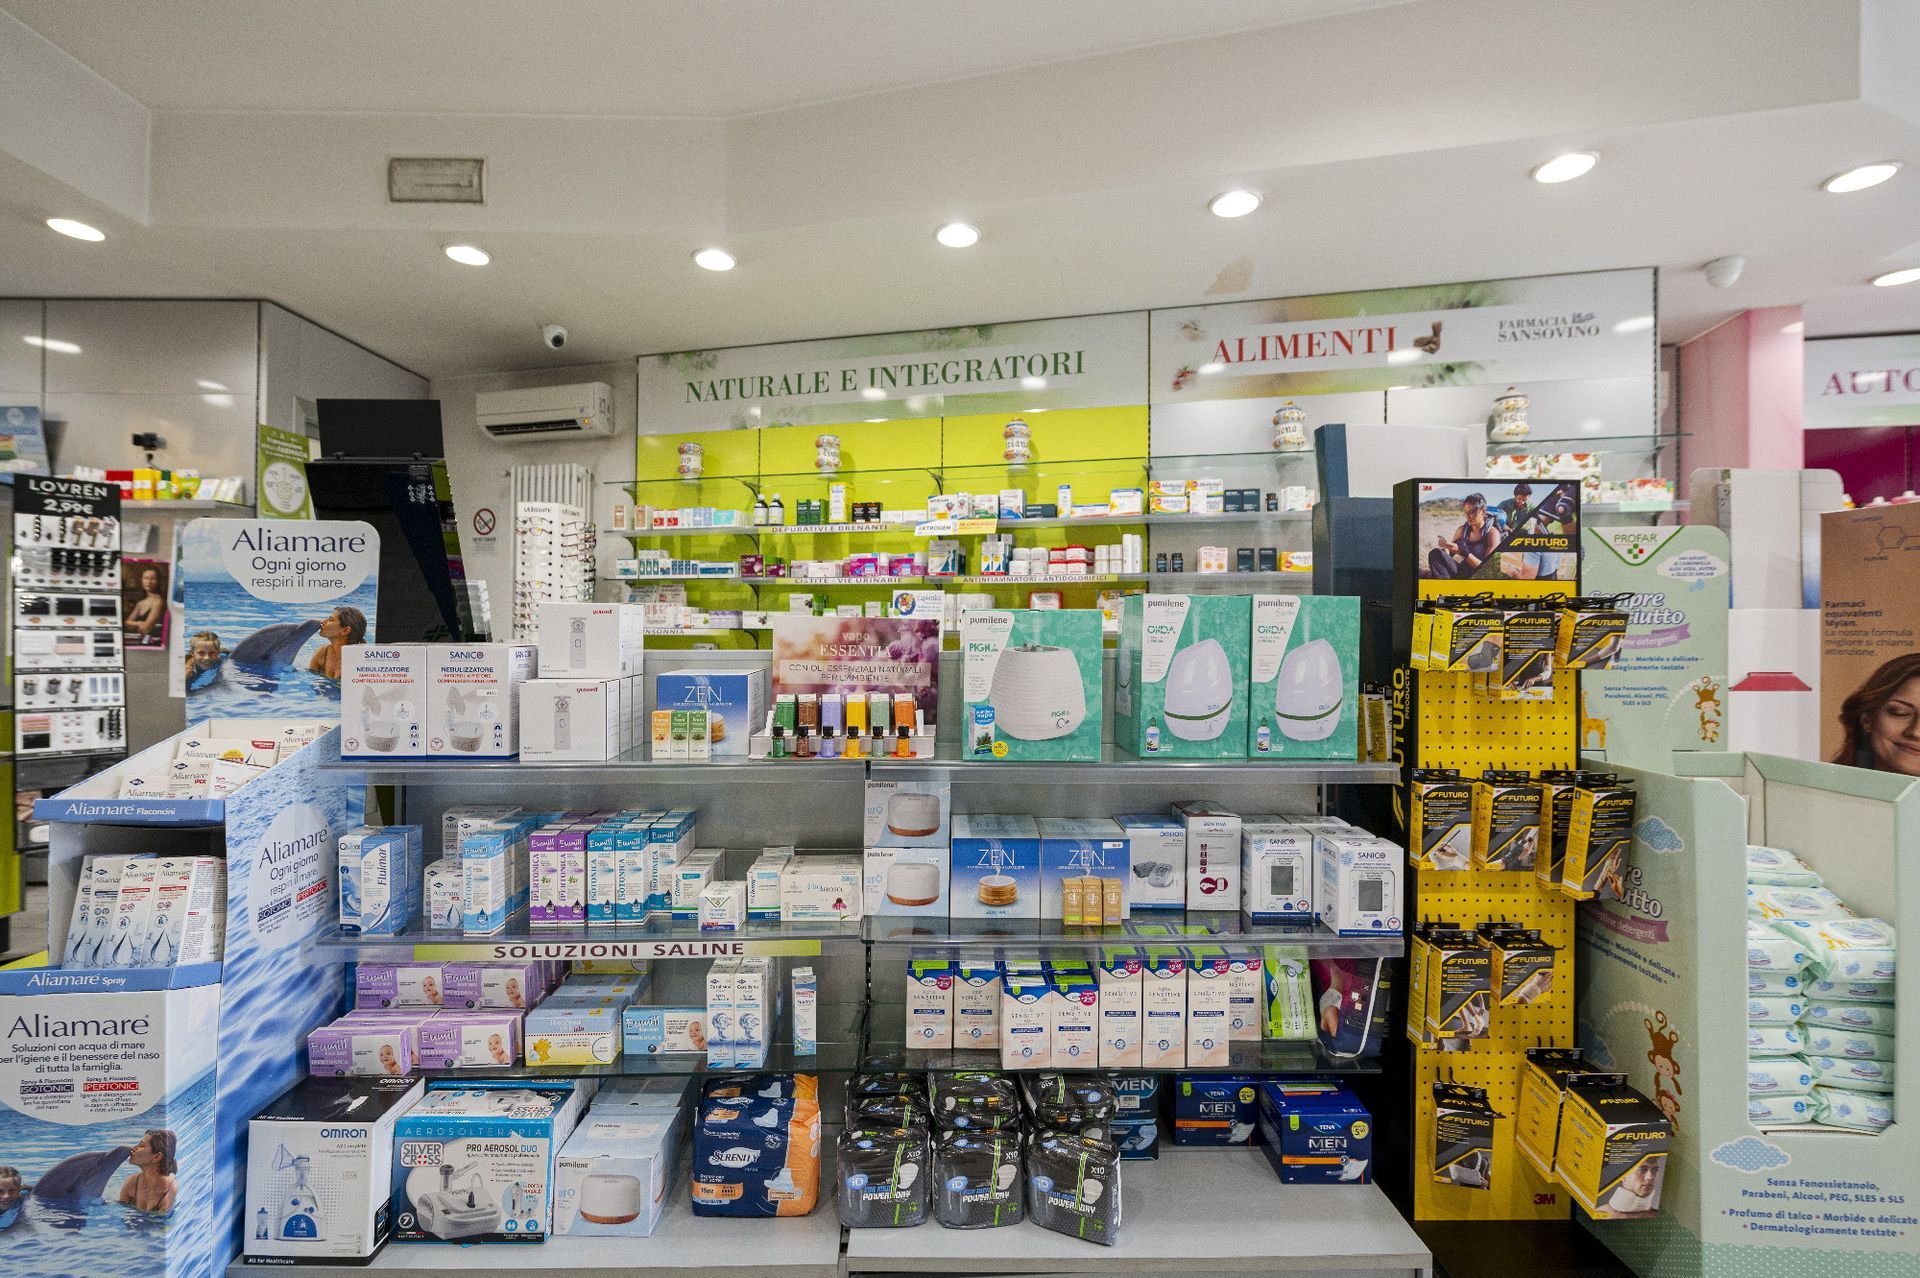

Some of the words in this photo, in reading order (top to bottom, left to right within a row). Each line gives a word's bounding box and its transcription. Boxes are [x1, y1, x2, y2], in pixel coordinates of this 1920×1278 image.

[1499, 316, 1567, 330] FARMACIA
[1498, 325, 1600, 344] SANSOVINO
[1212, 326, 1398, 364] ALIMENTI
[685, 371, 830, 403] NATURALE
[840, 369, 857, 392] E
[867, 350, 1086, 389] INTEGRATORI
[1524, 538, 1568, 547] FUTURO
[1614, 533, 1657, 543] PROFAR
[252, 557, 291, 575] Ogni
[295, 557, 346, 576] giorno
[251, 577, 294, 591] respiri
[298, 577, 304, 588] il
[308, 578, 346, 589] mare.
[1148, 599, 1184, 609] pumilene
[1258, 599, 1295, 609] pumilene
[969, 616, 1008, 625] pumilene
[842, 632, 869, 643] vapo
[820, 644, 892, 658] ESSENTIA
[685, 686, 721, 702] ZEN
[1393, 668, 1404, 787] FUTURO
[1606, 799, 1633, 807] FUTURO
[136, 808, 175, 816] Flaconcini
[978, 849, 1015, 866] ZEN
[1068, 850, 1105, 866] ZEN
[270, 861, 292, 881] Ogni
[293, 852, 319, 873] giorno
[494, 944, 638, 958] SOLUZIONI
[653, 943, 744, 956] SALINE
[102, 976, 126, 986] Spray
[11, 1043, 56, 1052] Soluzioni
[78, 1043, 107, 1052] acqua
[15, 1055, 51, 1065] l'igiene
[69, 1052, 119, 1061] benessere
[137, 1052, 160, 1060] naso
[35, 1065, 45, 1073] di
[47, 1064, 69, 1073] tutta
[72, 1063, 80, 1072] la
[82, 1063, 123, 1074] famiglia.
[20, 1084, 74, 1094] ISOTONICI
[84, 1082, 139, 1092] IPERTONICI
[1111, 1078, 1155, 1091] MEN
[1200, 1104, 1235, 1113] MEN
[1453, 1117, 1490, 1126] FUTURO
[320, 1128, 367, 1138] OMRON
[404, 1127, 544, 1138] AEROSOLTERAPIA
[1625, 1132, 1666, 1140] FUTURO
[466, 1144, 481, 1152] PRO
[484, 1144, 519, 1152] AEROSOL
[521, 1144, 538, 1152] DUO
[1309, 1138, 1347, 1148] MEN
[403, 1143, 441, 1155] SILVER
[558, 1161, 588, 1169] pumilene
[1090, 1167, 1105, 1175] X10
[1767, 1178, 1797, 1187] Senza
[1799, 1179, 1880, 1191] Fenossietanolo,
[1533, 1194, 1556, 1205] 3M
[1742, 1189, 1790, 1200] Parabeni,
[1792, 1191, 1827, 1202] Alcool,
[1829, 1194, 1852, 1203] PEG,
[1854, 1194, 1877, 1203] SLES
[1888, 1195, 1905, 1203] SLS
[1729, 1208, 1772, 1219] Profumo
[1775, 1210, 1785, 1219] di
[1788, 1211, 1812, 1221] talco
[1823, 1213, 1866, 1223] Morbide
[1877, 1215, 1918, 1225] delicate
[1750, 1222, 1857, 1236] Dermatologicamente
[1860, 1228, 1897, 1237] testate
